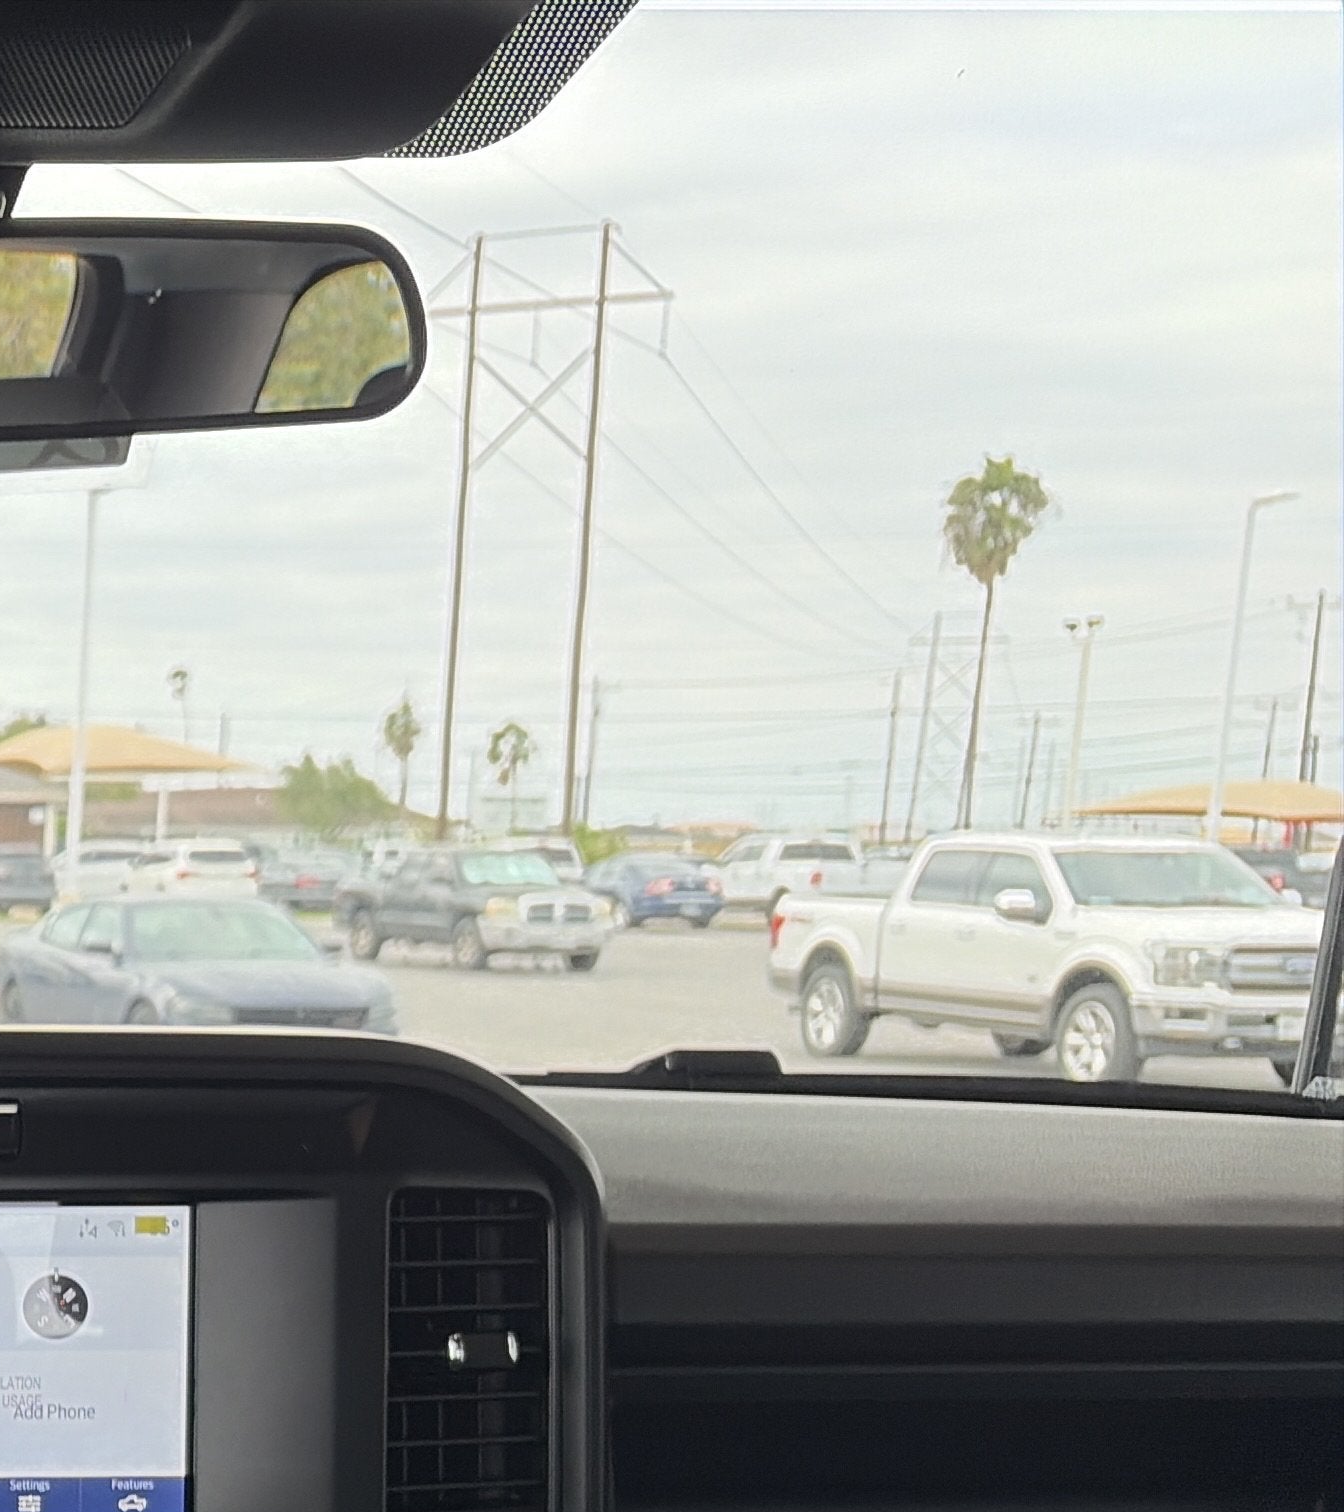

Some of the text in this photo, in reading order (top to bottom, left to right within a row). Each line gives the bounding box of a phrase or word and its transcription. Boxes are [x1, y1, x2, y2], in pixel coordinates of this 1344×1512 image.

[13, 1404, 96, 1421] Add Phone
[9, 1479, 50, 1494] Settings
[111, 1479, 154, 1492] Features
